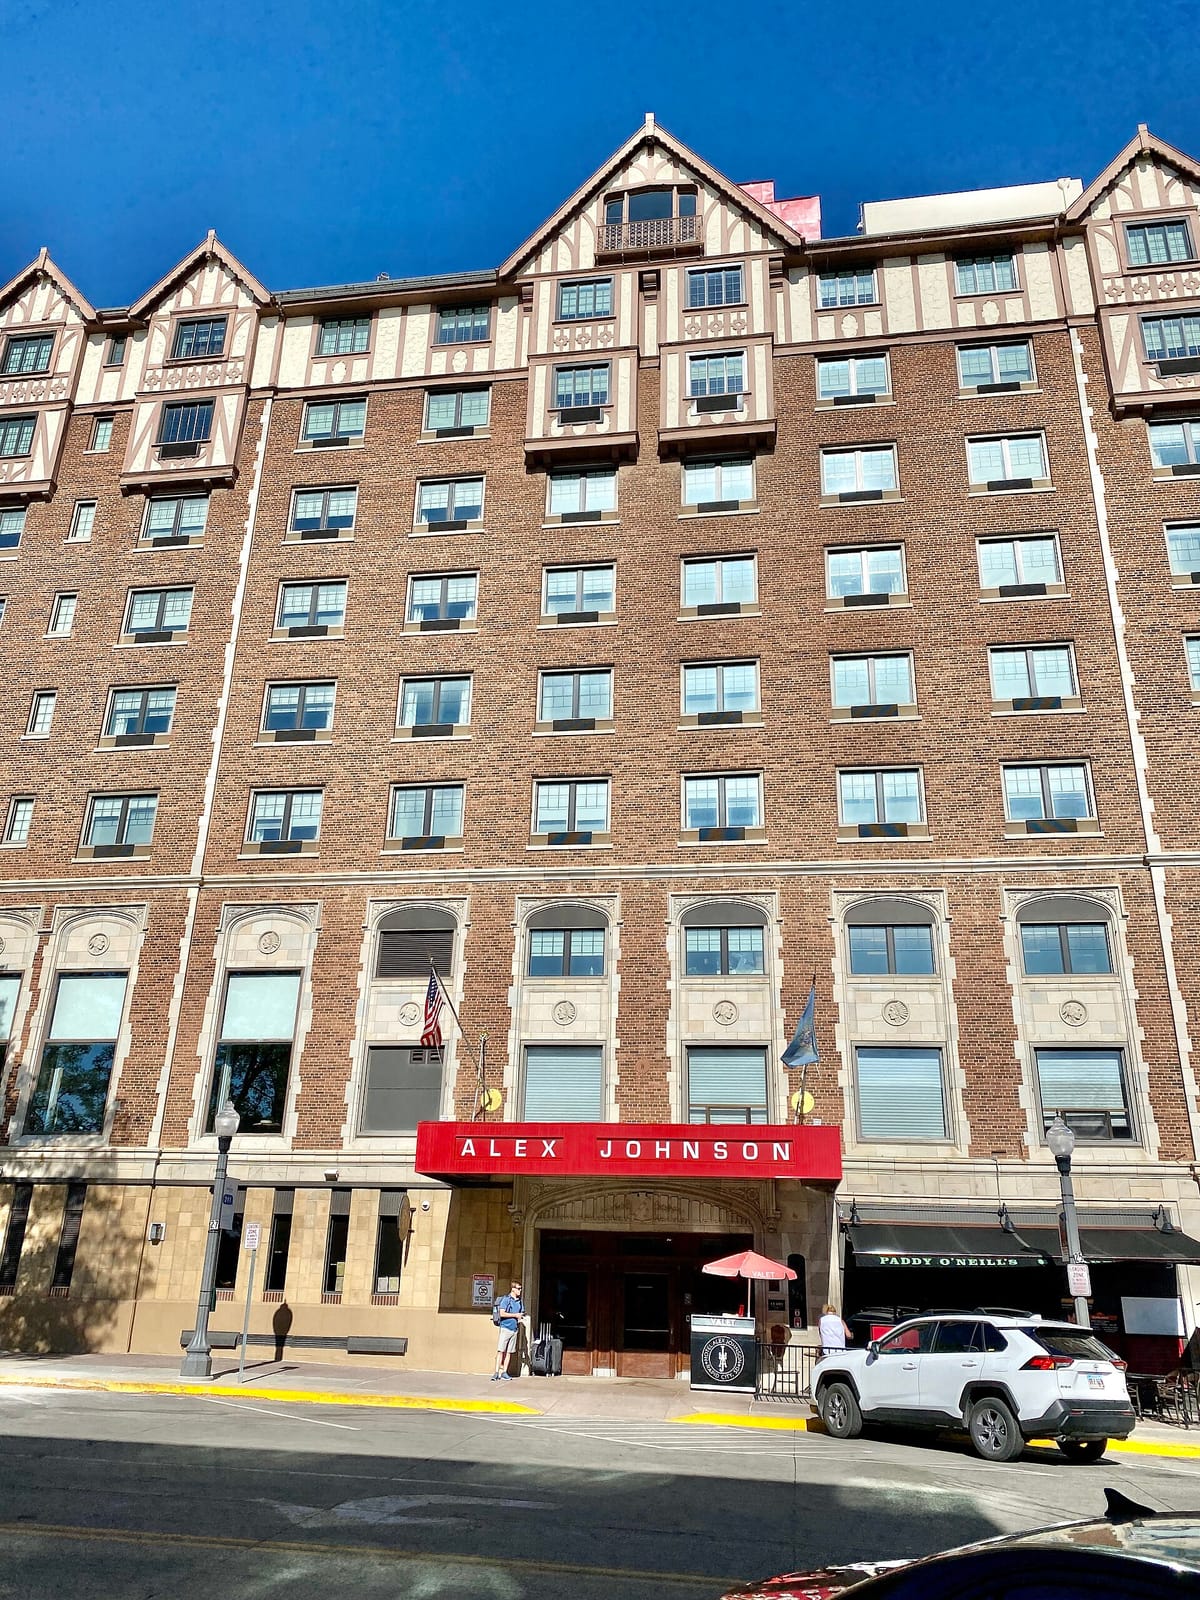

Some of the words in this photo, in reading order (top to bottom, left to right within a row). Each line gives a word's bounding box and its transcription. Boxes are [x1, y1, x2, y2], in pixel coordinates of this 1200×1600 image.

[460, 1139, 557, 1158] ALEX
[600, 1140, 790, 1161] JOHNSON
[879, 1256, 933, 1265] PADDY
[939, 1257, 1018, 1266] O'NEILL'S
[711, 1317, 737, 1326] VALET
